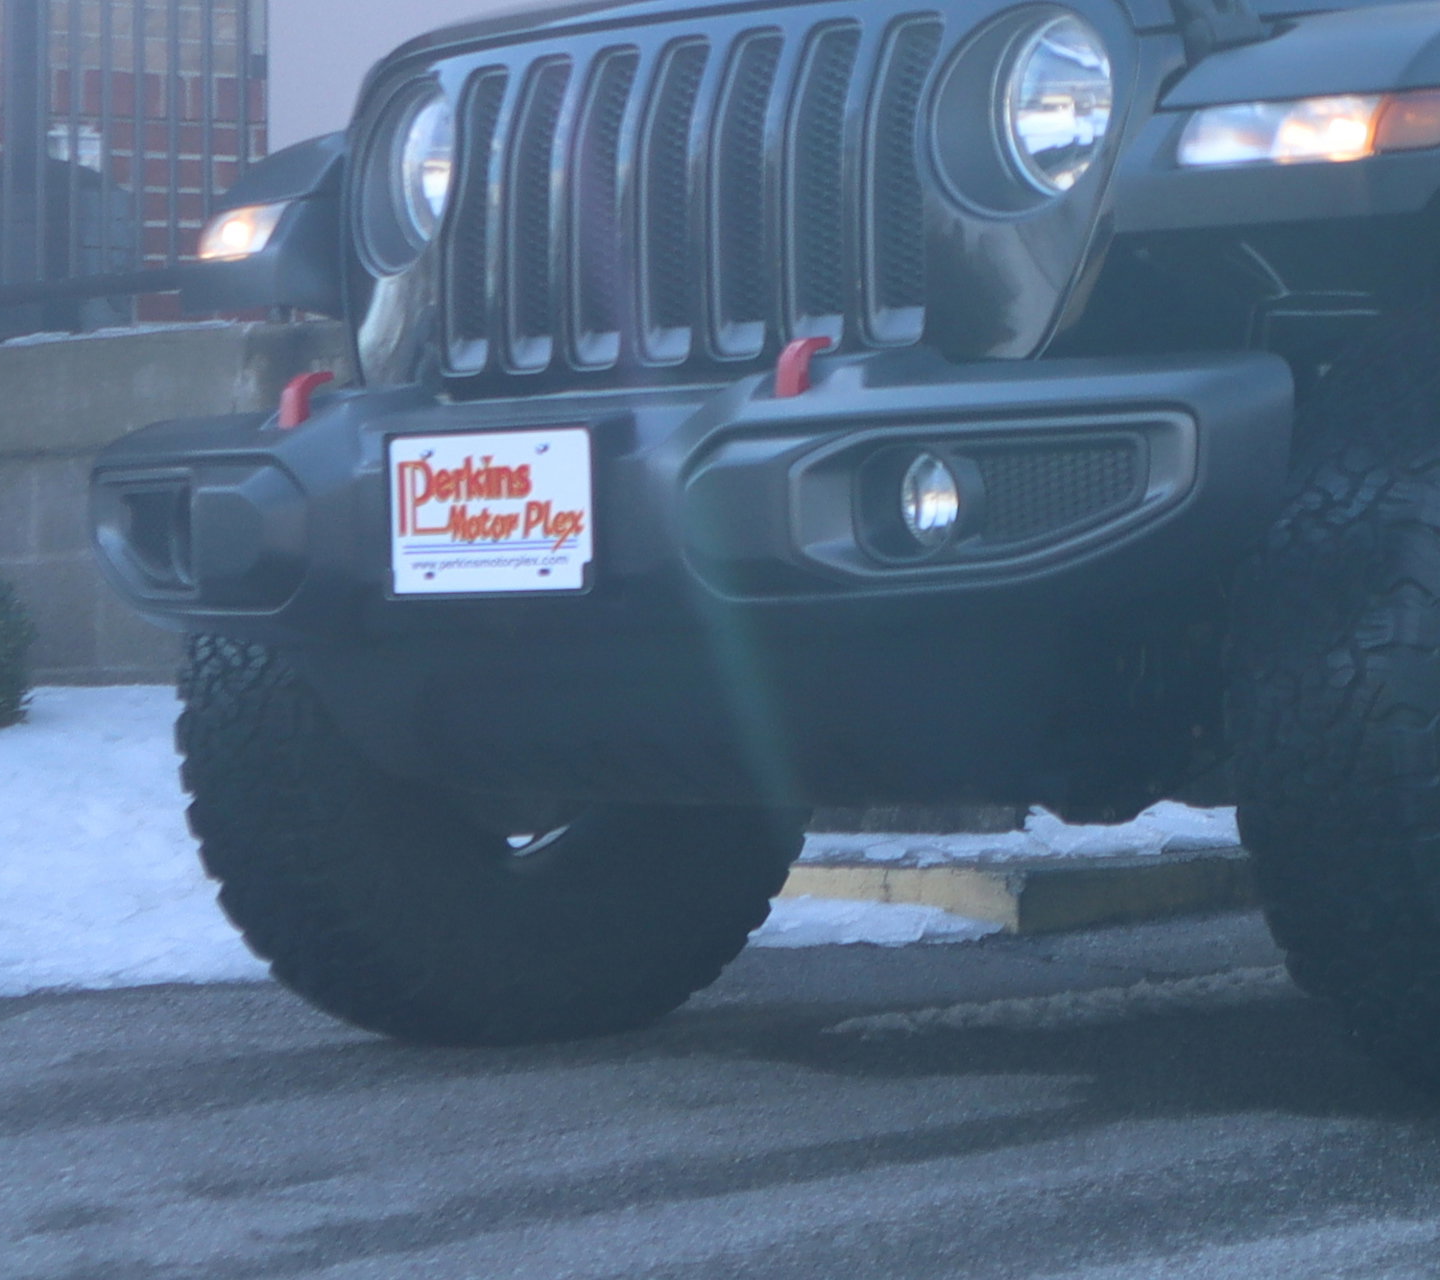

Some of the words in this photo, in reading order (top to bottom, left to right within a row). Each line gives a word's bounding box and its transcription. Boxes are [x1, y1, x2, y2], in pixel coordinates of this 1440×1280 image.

[397, 453, 533, 537] Perkins
[448, 502, 520, 545] Motor
[523, 499, 585, 553] Plex
[410, 554, 570, 572] www.perkinsmotorplex.com
